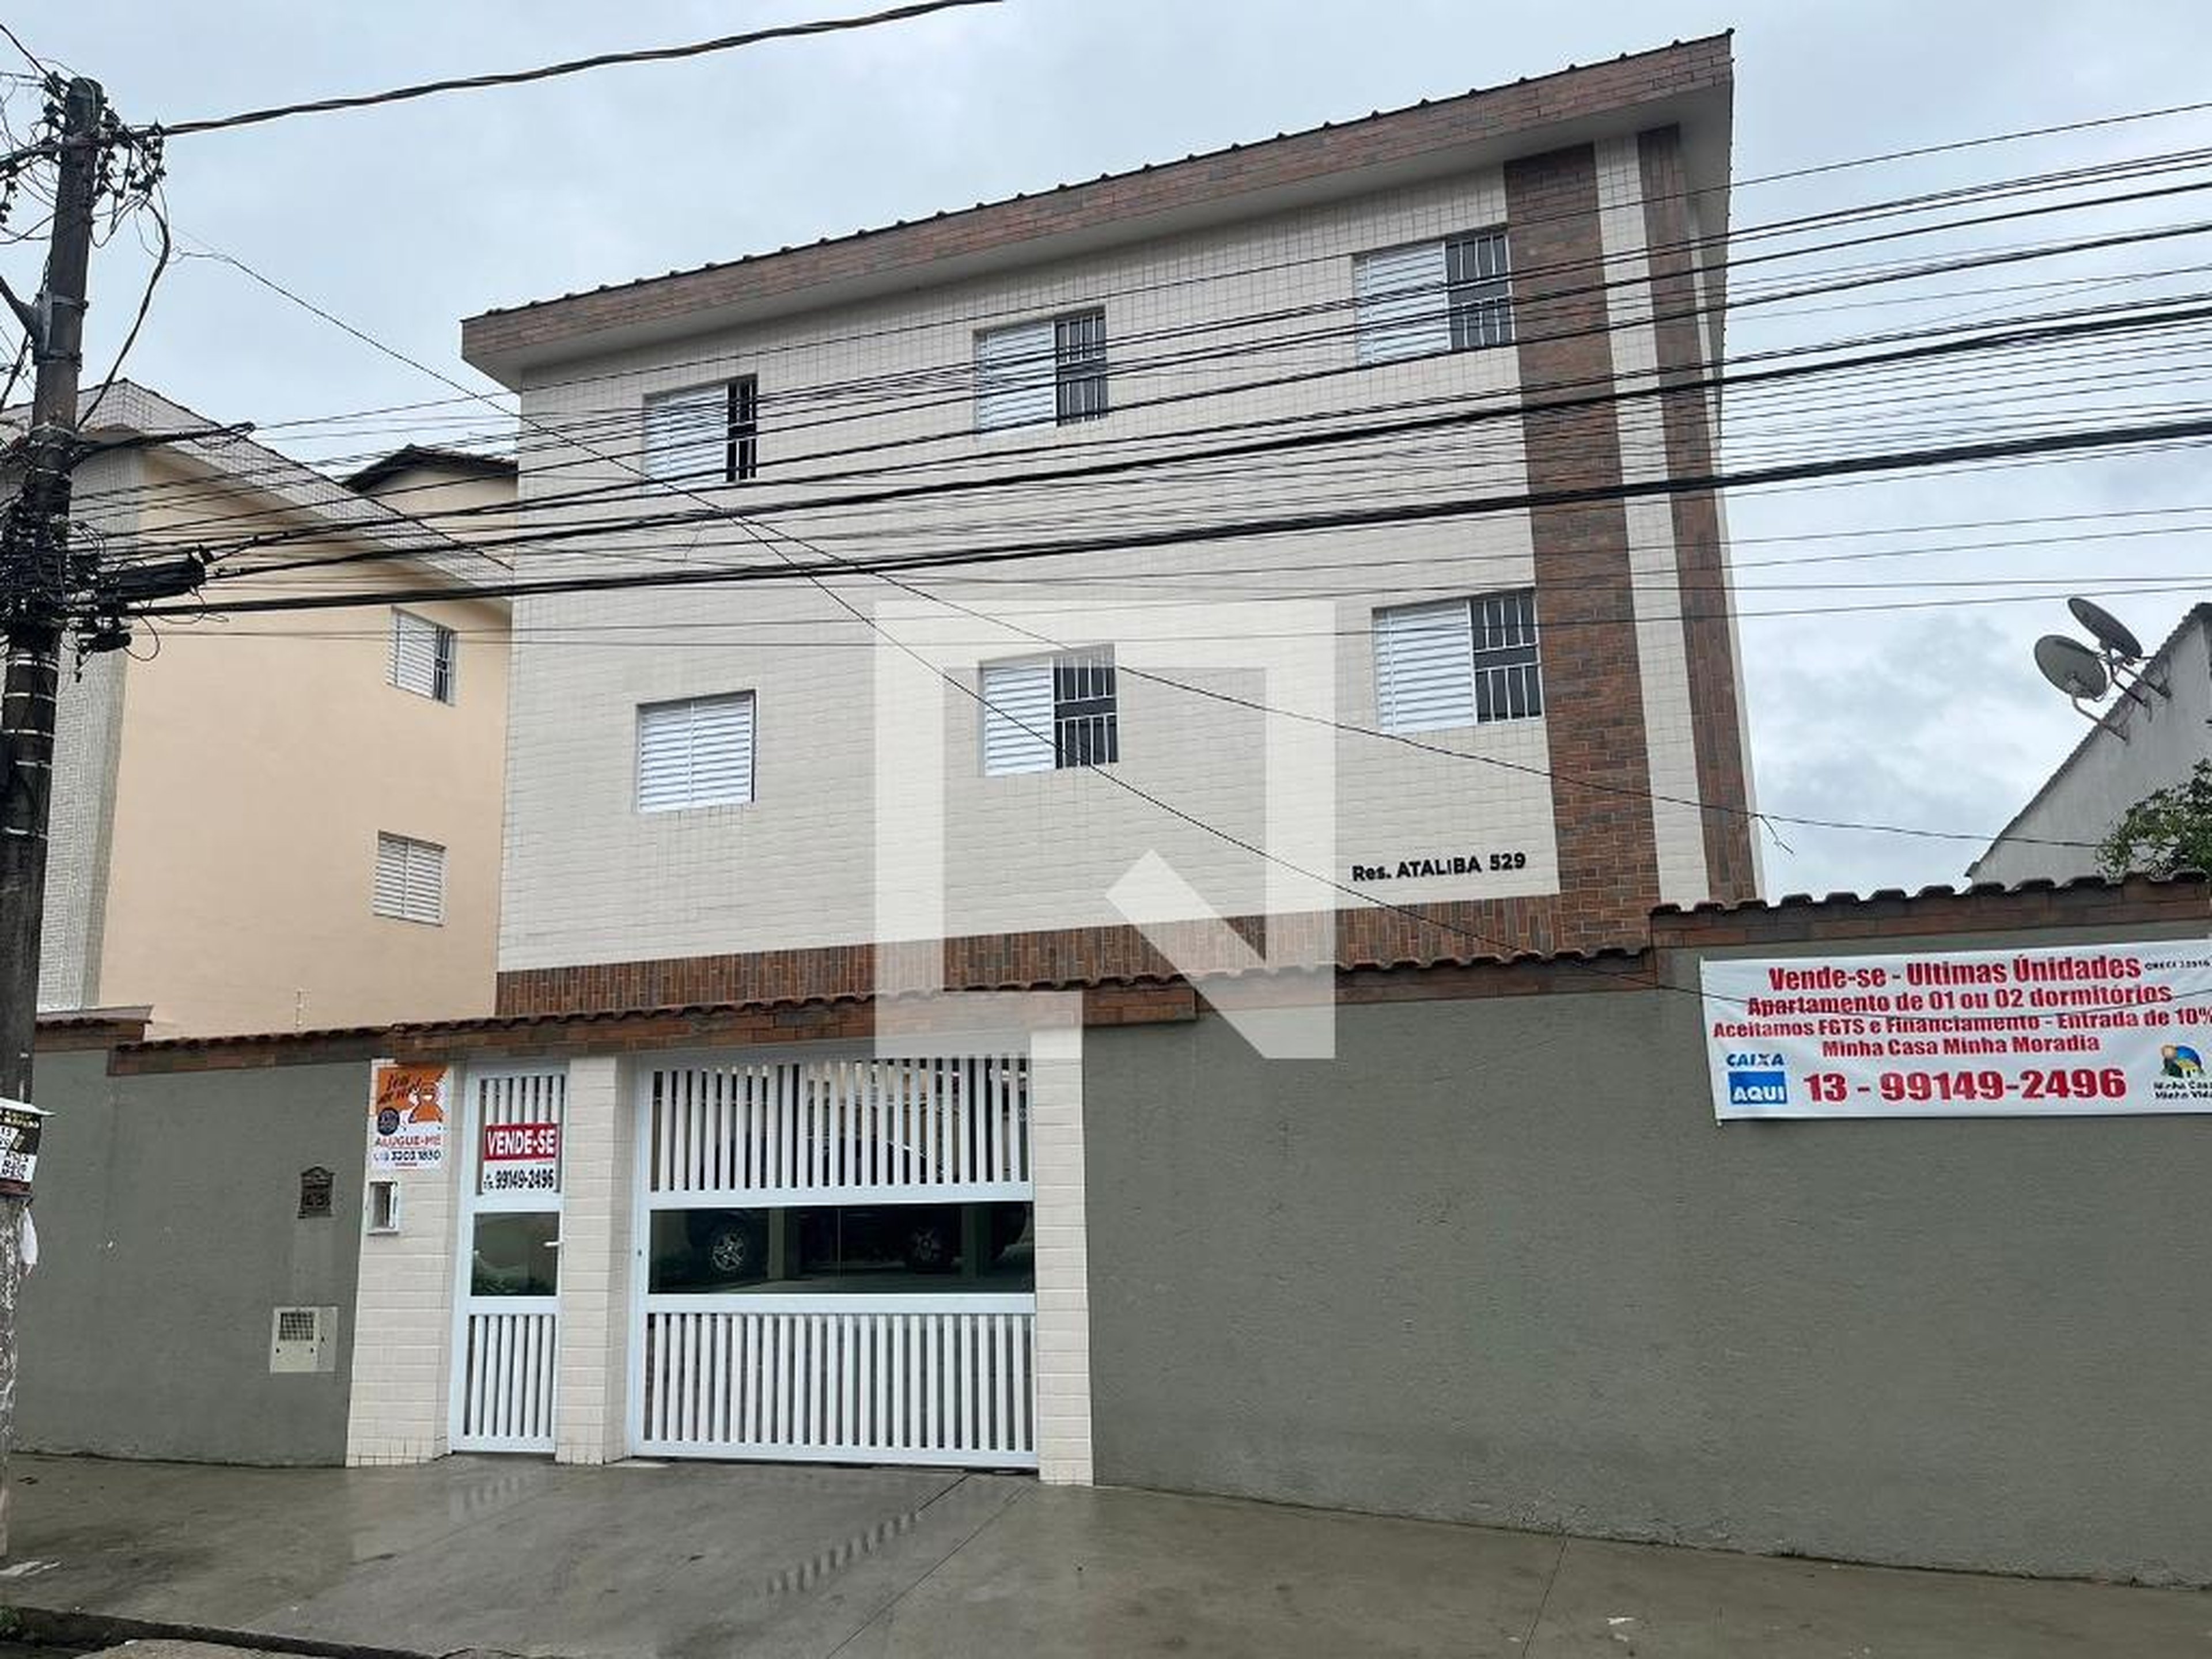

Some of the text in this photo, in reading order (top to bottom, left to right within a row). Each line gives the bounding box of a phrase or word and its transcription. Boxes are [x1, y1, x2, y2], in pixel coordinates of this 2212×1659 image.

[1352, 852, 1527, 882] Res. ATALIBA 529
[1768, 966, 1887, 991] Vende-se
[1907, 960, 2008, 987] Ultimas
[2013, 954, 2142, 983] Únidades
[1747, 984, 2173, 1018] Apartamento de 01 ou 02 dormitórios
[1713, 1021, 1815, 1039] Aceitamos
[1819, 1018, 1866, 1036] FGTS
[1869, 1020, 1882, 1035] e
[1887, 1015, 2041, 1035] Financiamento
[2057, 1011, 2139, 1030] Entrada
[2143, 1009, 2171, 1028] de
[1726, 1054, 1785, 1067] CAIXA
[1822, 1035, 2101, 1058] Minha Casa Minha Moradia
[1733, 1086, 1785, 1102] AQUI
[1803, 1073, 1848, 1103] 13
[1879, 1068, 2127, 1101] 99149-2496
[487, 1128, 555, 1157] VENDE-SE
